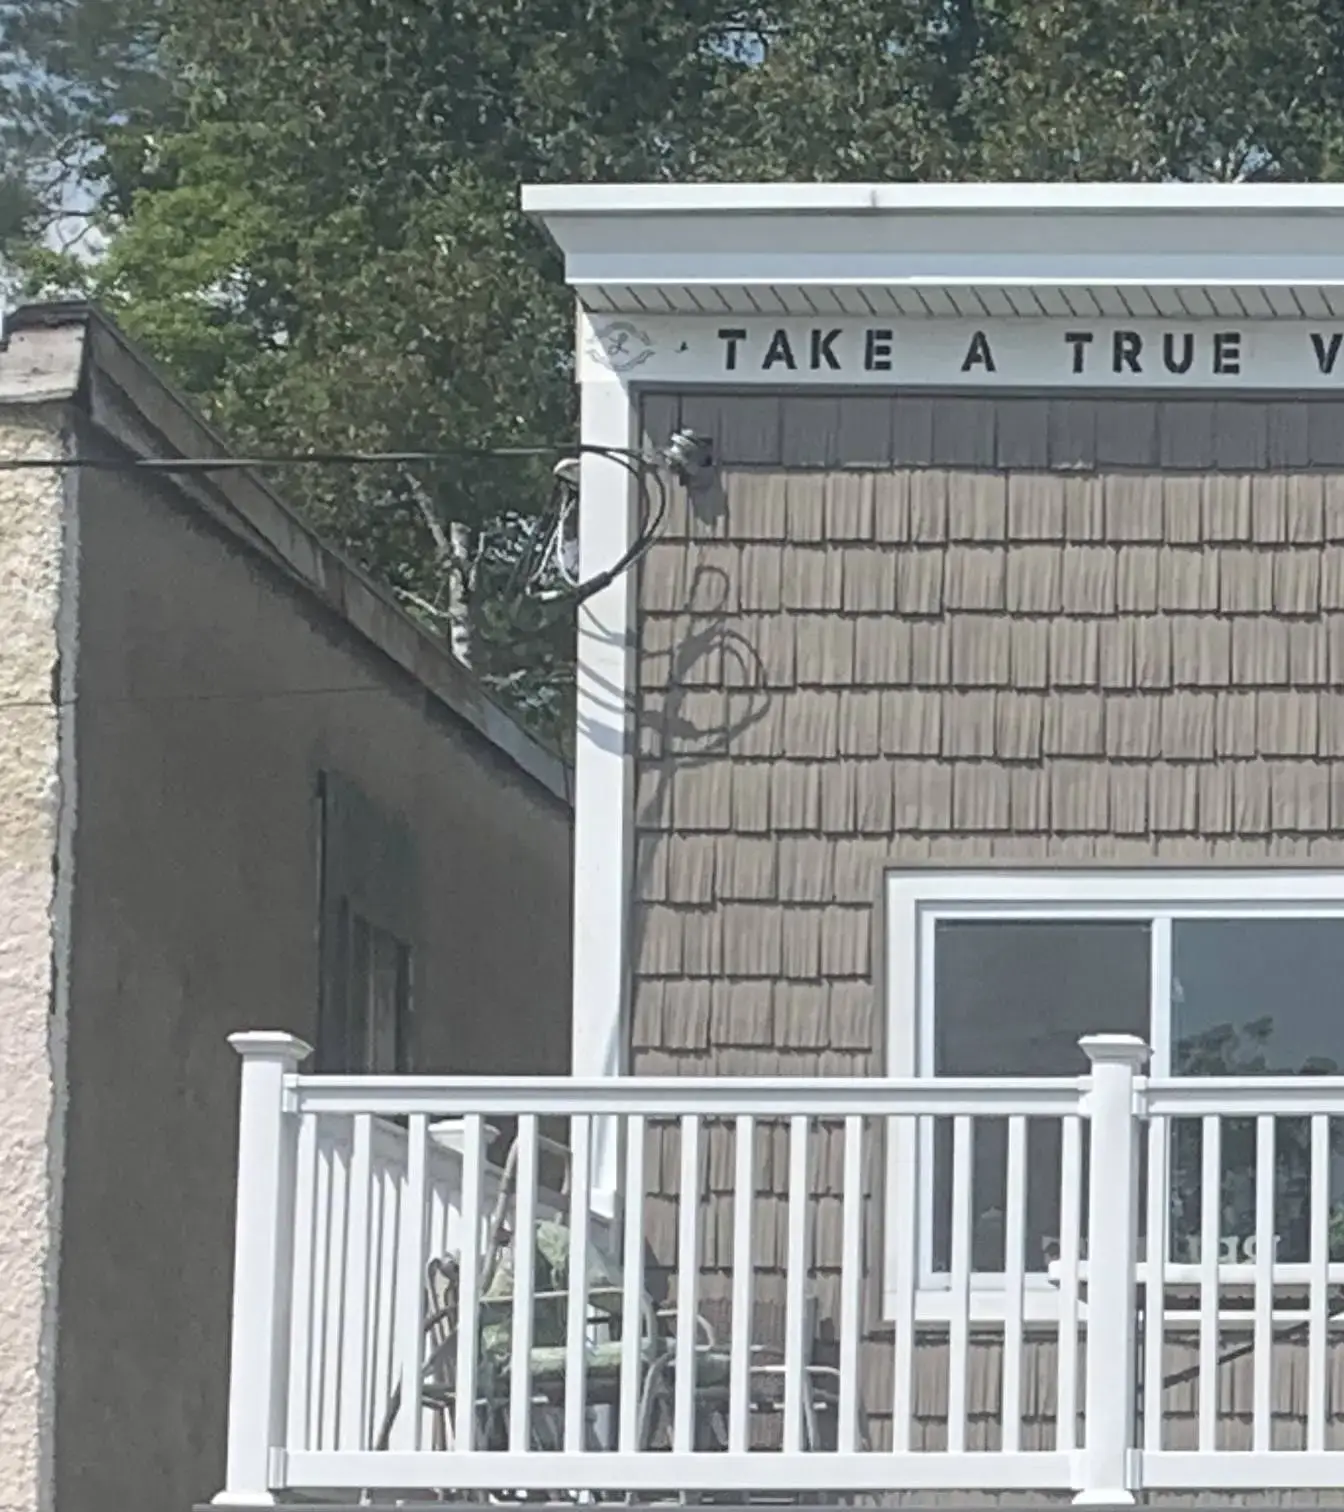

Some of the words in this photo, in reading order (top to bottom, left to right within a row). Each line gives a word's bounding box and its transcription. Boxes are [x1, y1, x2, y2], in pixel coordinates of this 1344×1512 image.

[717, 327, 893, 373] TAKE
[961, 330, 996, 372] A
[1064, 331, 1241, 375] TRUE
